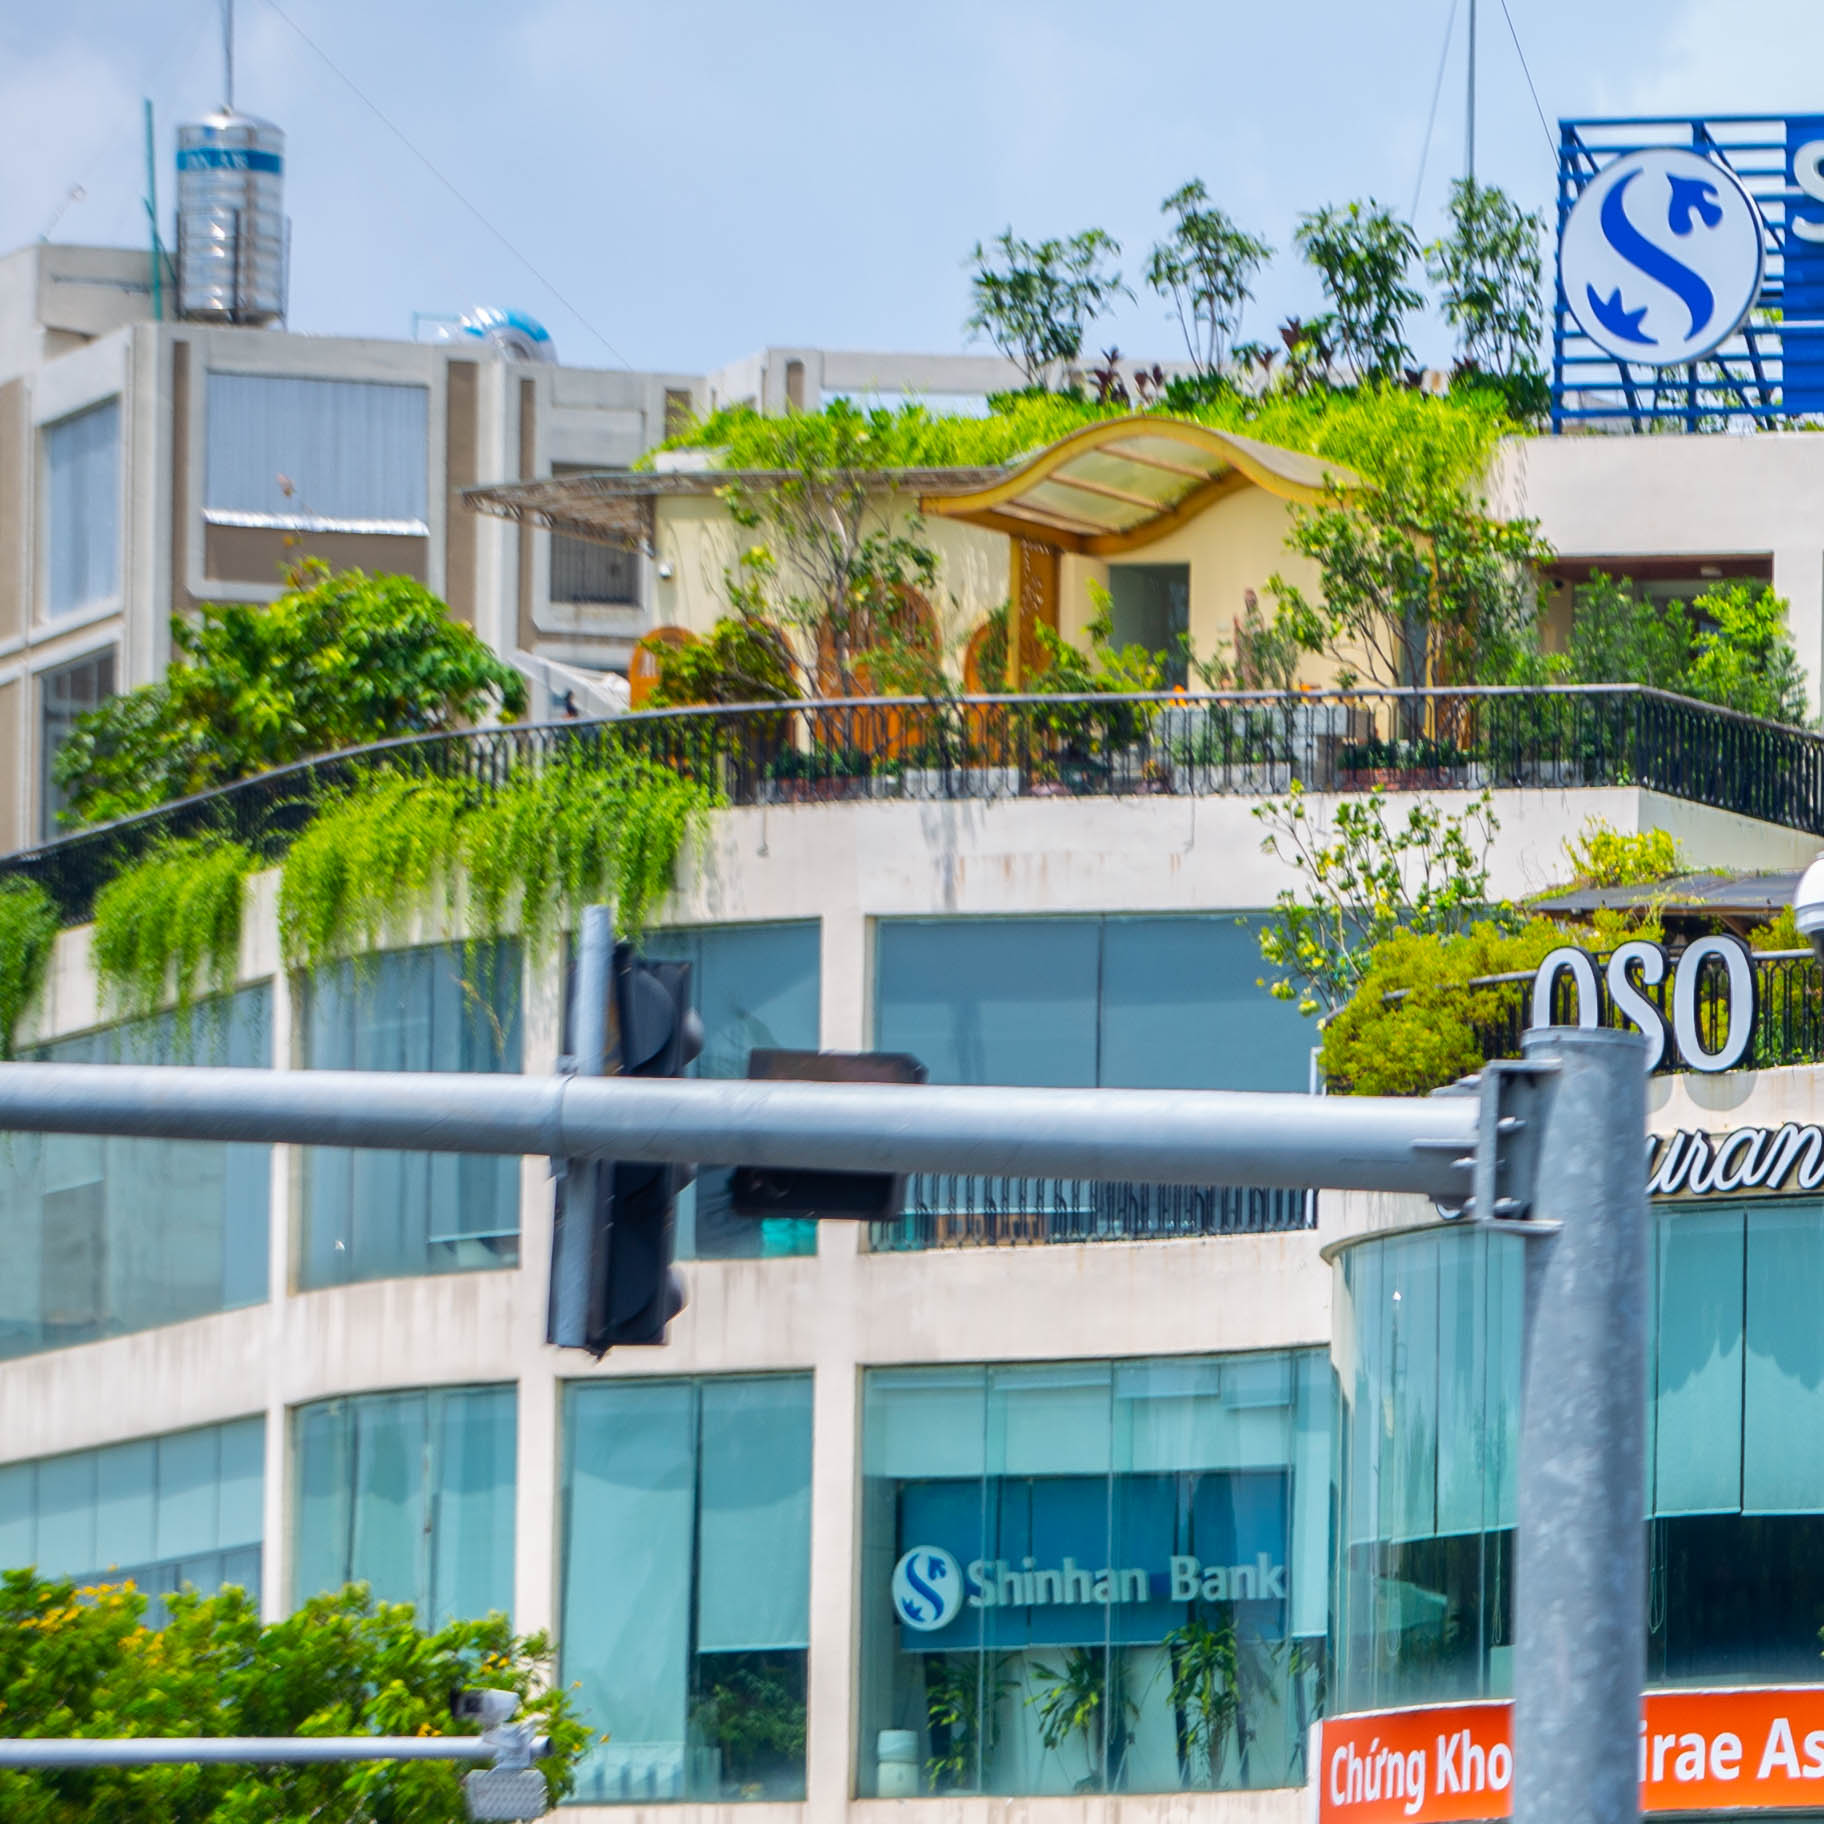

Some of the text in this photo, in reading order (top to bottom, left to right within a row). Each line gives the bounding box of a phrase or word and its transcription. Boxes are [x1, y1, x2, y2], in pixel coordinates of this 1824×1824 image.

[966, 1552, 1288, 1609] Shinhan Bank
[1331, 1735, 1426, 1816] Chứng
[1436, 1728, 1512, 1797] Kho
[1638, 1718, 1742, 1783] irae
